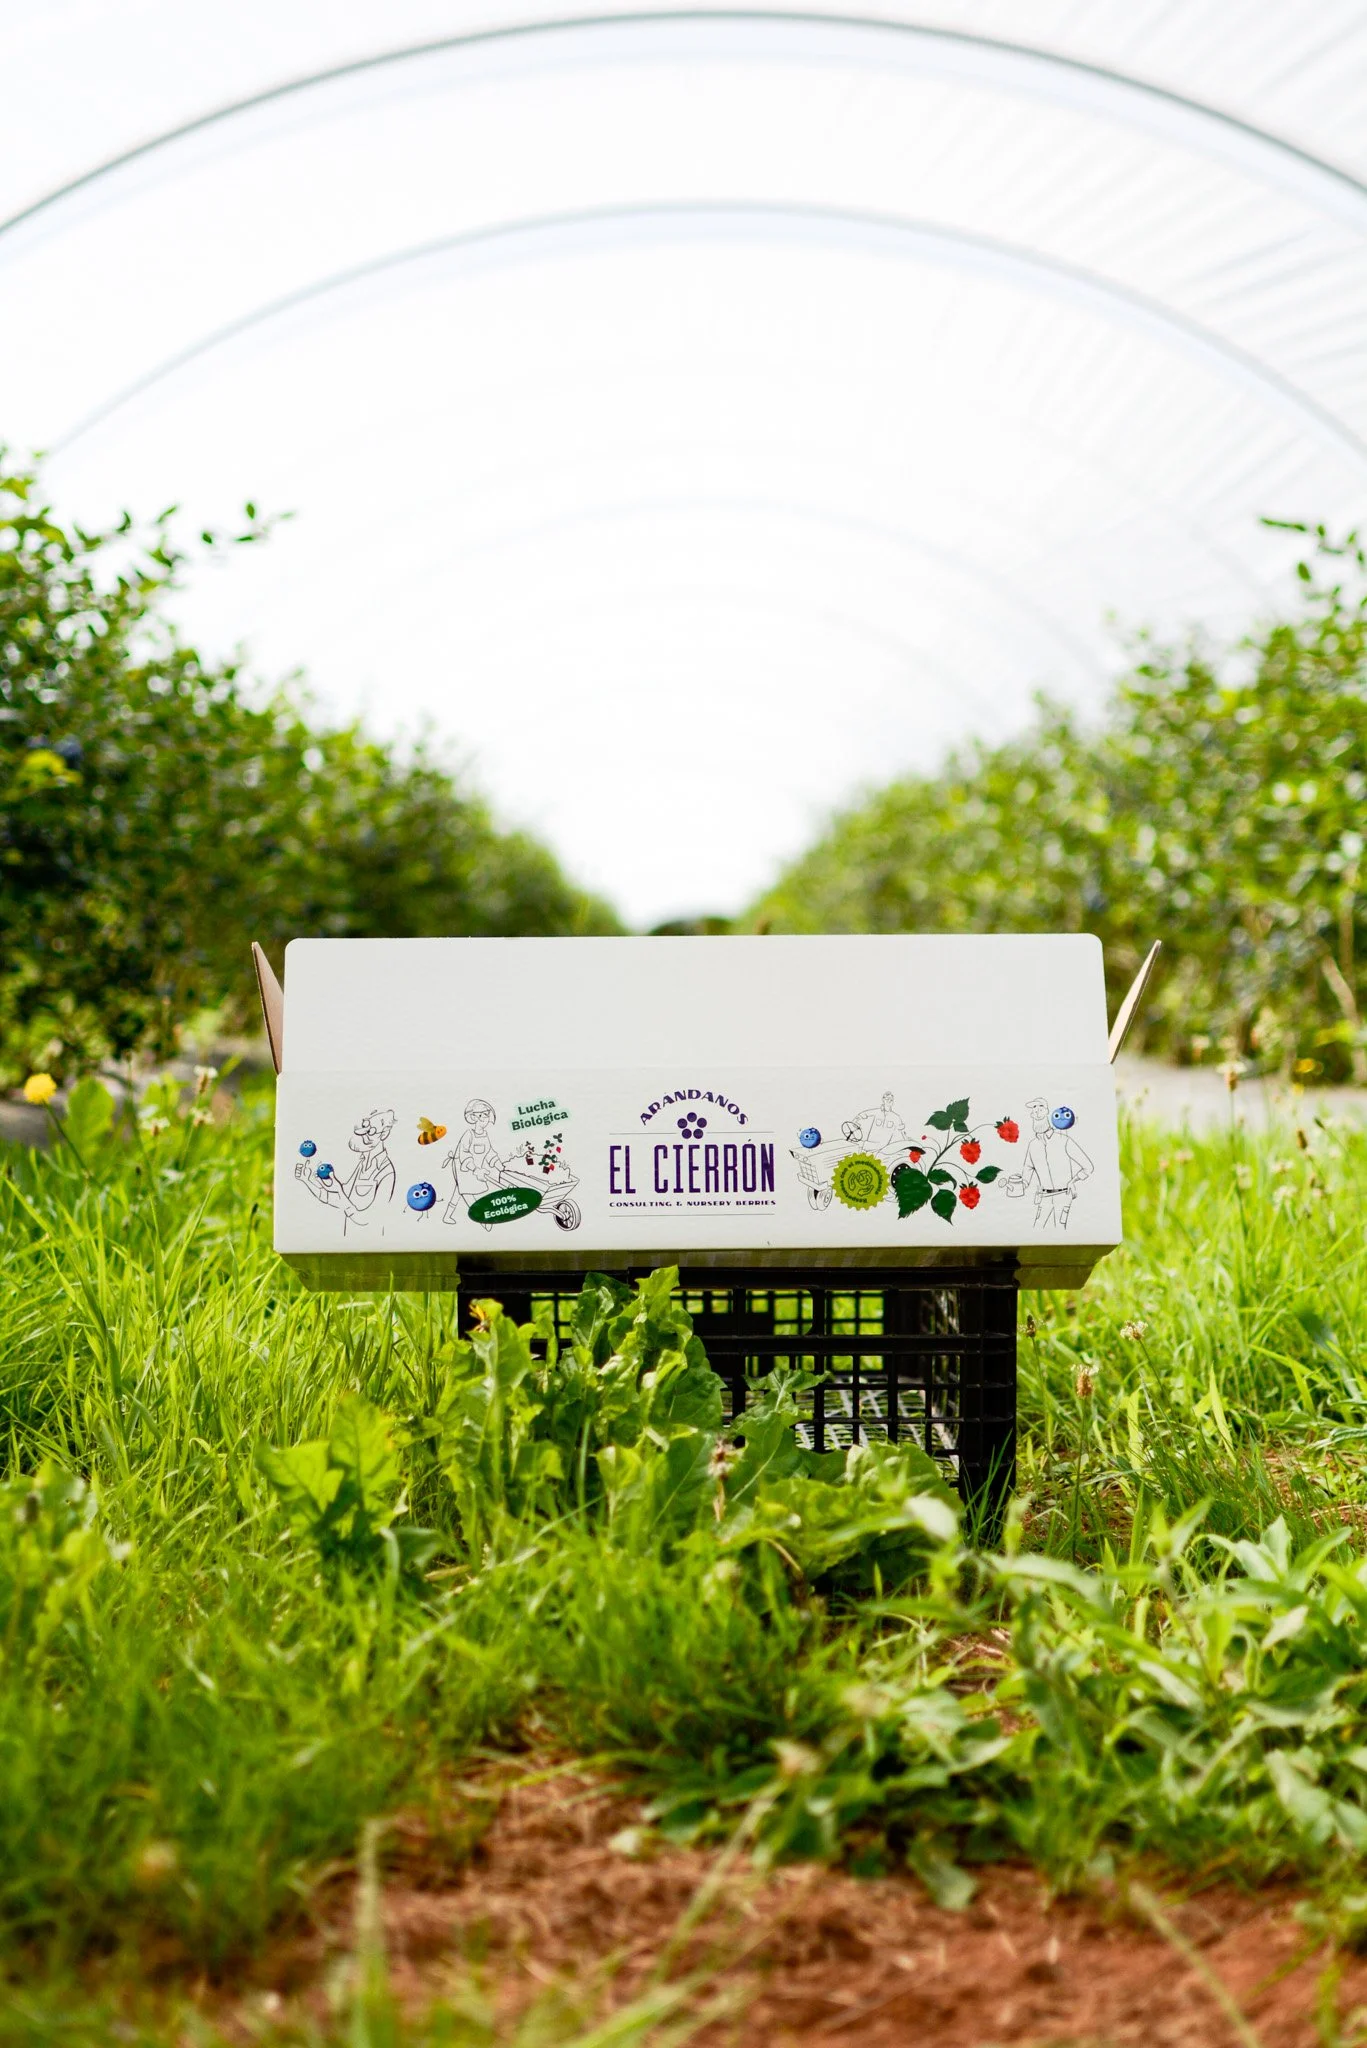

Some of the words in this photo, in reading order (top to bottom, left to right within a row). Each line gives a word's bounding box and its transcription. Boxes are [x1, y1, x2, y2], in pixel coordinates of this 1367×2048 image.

[518, 1100, 556, 1115] Lucha
[512, 1111, 568, 1131] Biológica
[609, 1145, 636, 1194] EL
[654, 1138, 776, 1194] CIERRÓN
[490, 1194, 517, 1208] 100%
[484, 1202, 529, 1220] Ecológica
